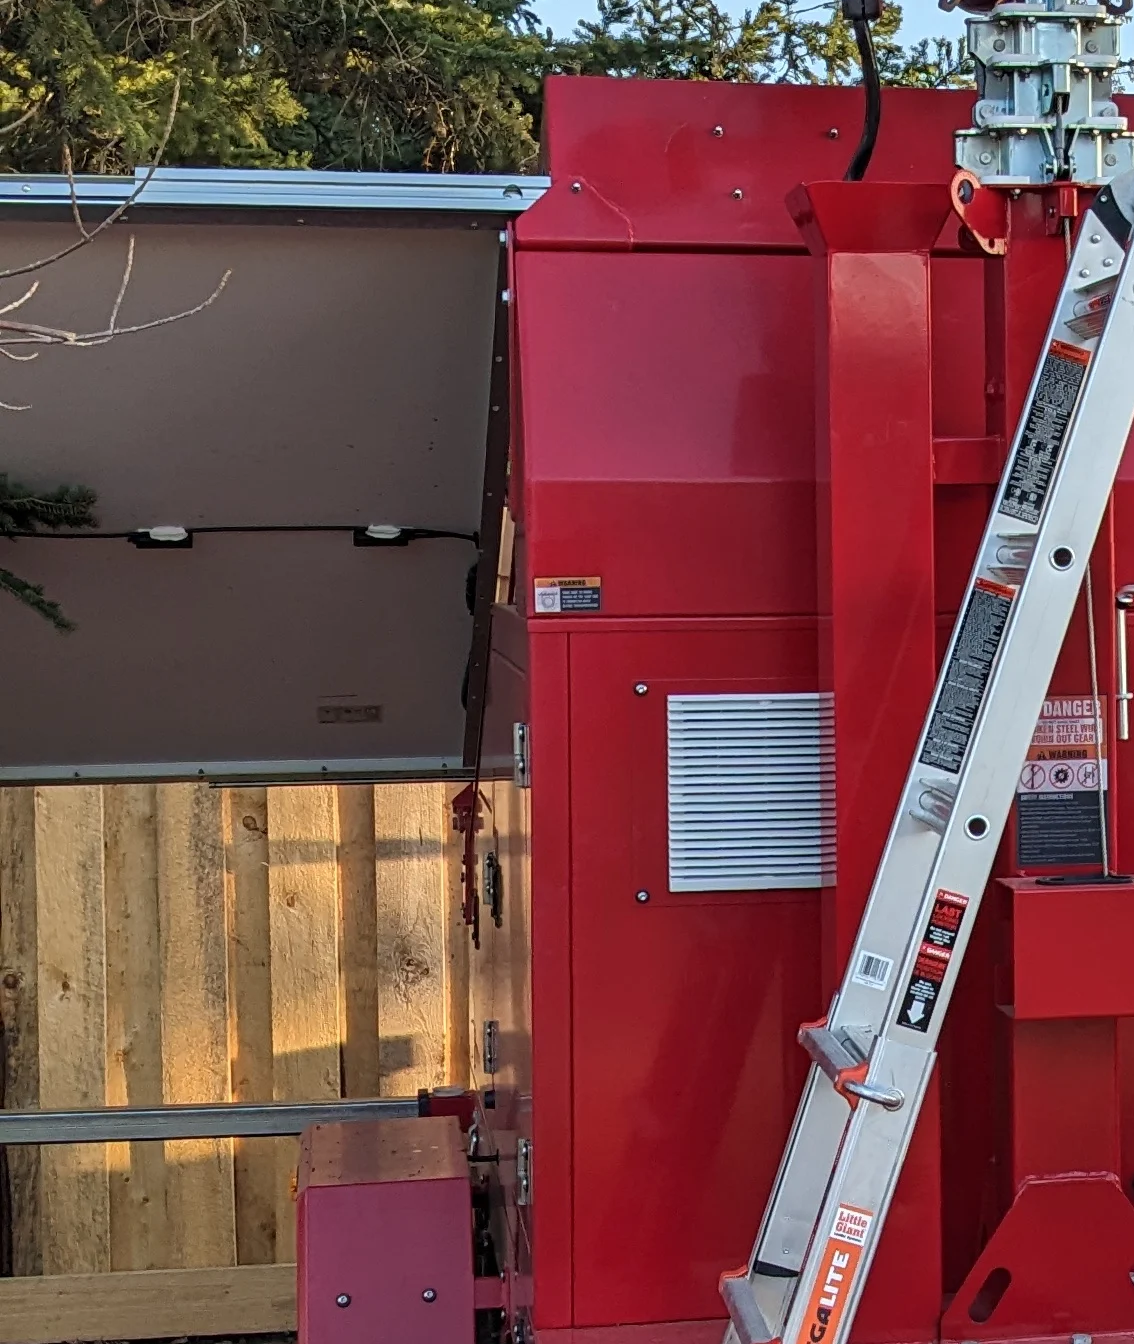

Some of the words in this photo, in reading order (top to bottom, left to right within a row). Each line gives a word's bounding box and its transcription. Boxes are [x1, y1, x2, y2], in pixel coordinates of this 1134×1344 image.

[1056, 723, 1079, 734] STEEL
[1048, 749, 1088, 759] WARNING
[935, 904, 963, 918] LAST
[838, 1210, 868, 1228] Little
[835, 1221, 865, 1238] Giant
